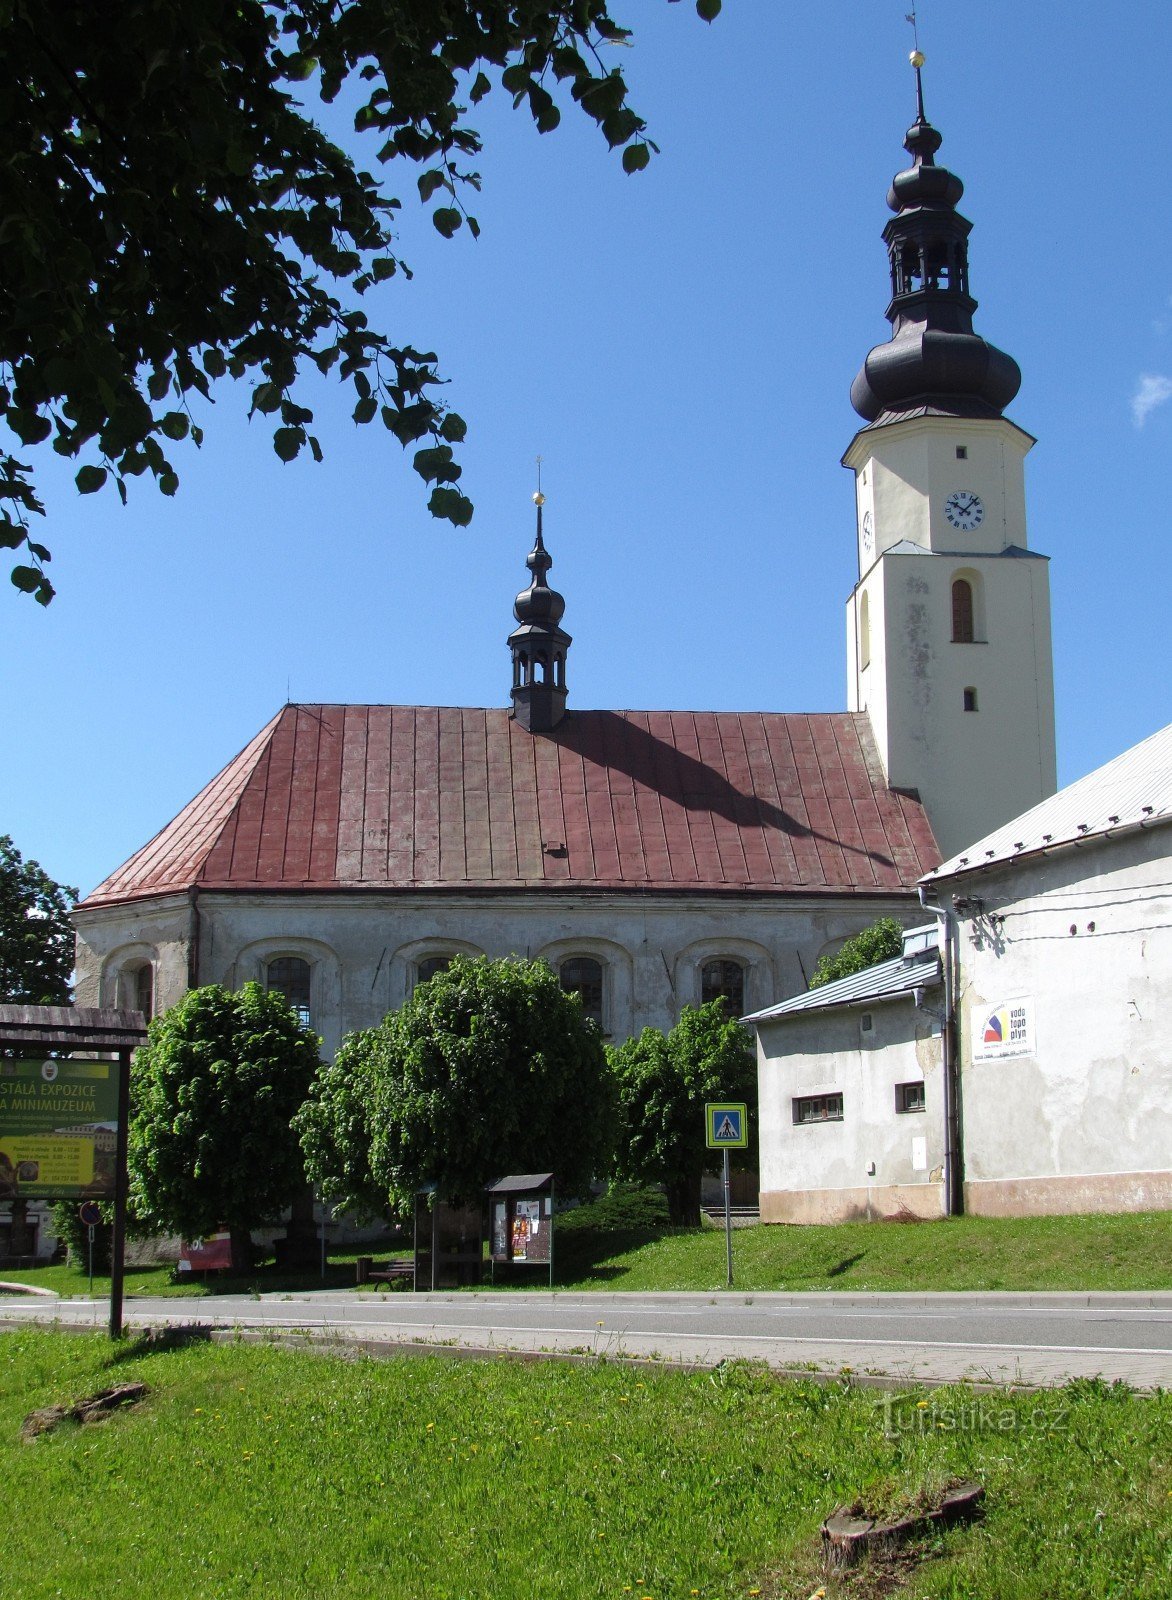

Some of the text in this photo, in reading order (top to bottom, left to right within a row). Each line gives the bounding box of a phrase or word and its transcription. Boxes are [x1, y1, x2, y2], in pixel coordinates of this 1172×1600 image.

[1010, 1018, 1026, 1028] topo
[1010, 1029, 1027, 1040] plyn
[0, 1081, 97, 1096] STÁLÁ EXPOZICE
[11, 1099, 95, 1111] MINIMUZEUM
